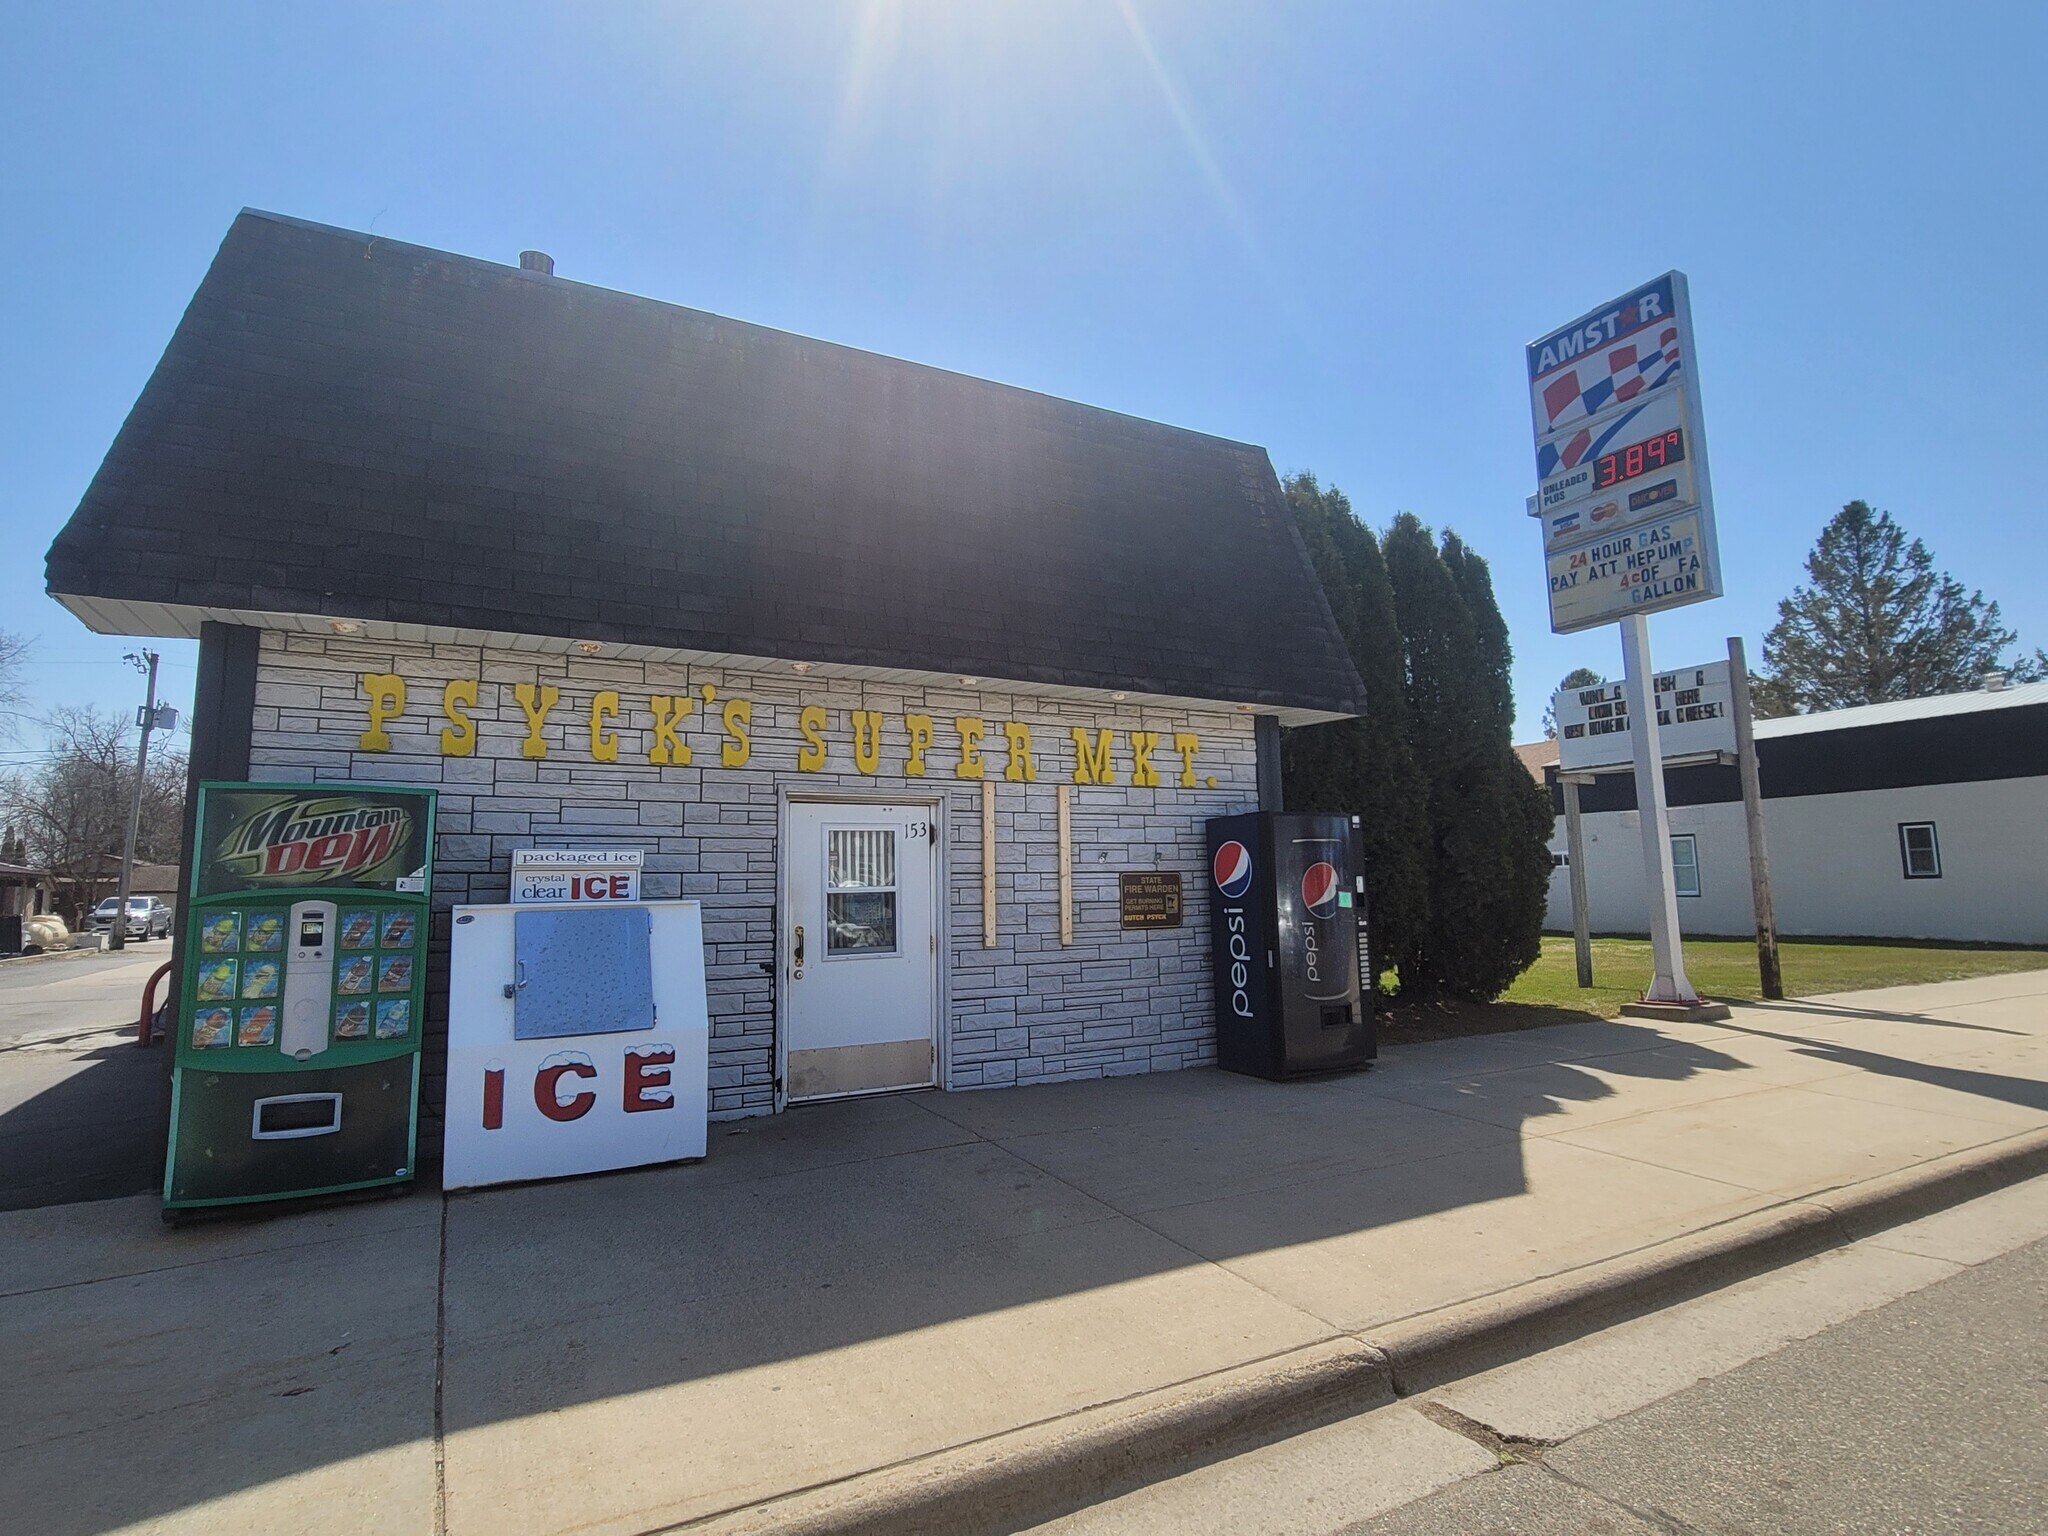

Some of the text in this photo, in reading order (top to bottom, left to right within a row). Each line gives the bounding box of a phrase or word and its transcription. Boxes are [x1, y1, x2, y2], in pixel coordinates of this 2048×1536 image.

[1543, 472, 1588, 496] UNLEADED
[1544, 491, 1566, 506] PLUS
[1569, 525, 1671, 569] 24 HOUR GAS
[1550, 571, 1578, 591] PAY
[1631, 573, 1696, 604] GALLON
[360, 673, 1218, 788] PSYCK'S SUPER MKT.
[244, 804, 401, 853] Mountain
[904, 822, 927, 839] 153
[522, 852, 637, 863] packaged ice
[522, 884, 567, 899] clear
[525, 874, 565, 884] crystal
[570, 872, 630, 900] ICE
[1124, 884, 1179, 893] FIRE WARDEN
[1224, 908, 1254, 1018] pepsi
[1301, 921, 1321, 982] pepsi
[483, 1043, 675, 1130] ICE
